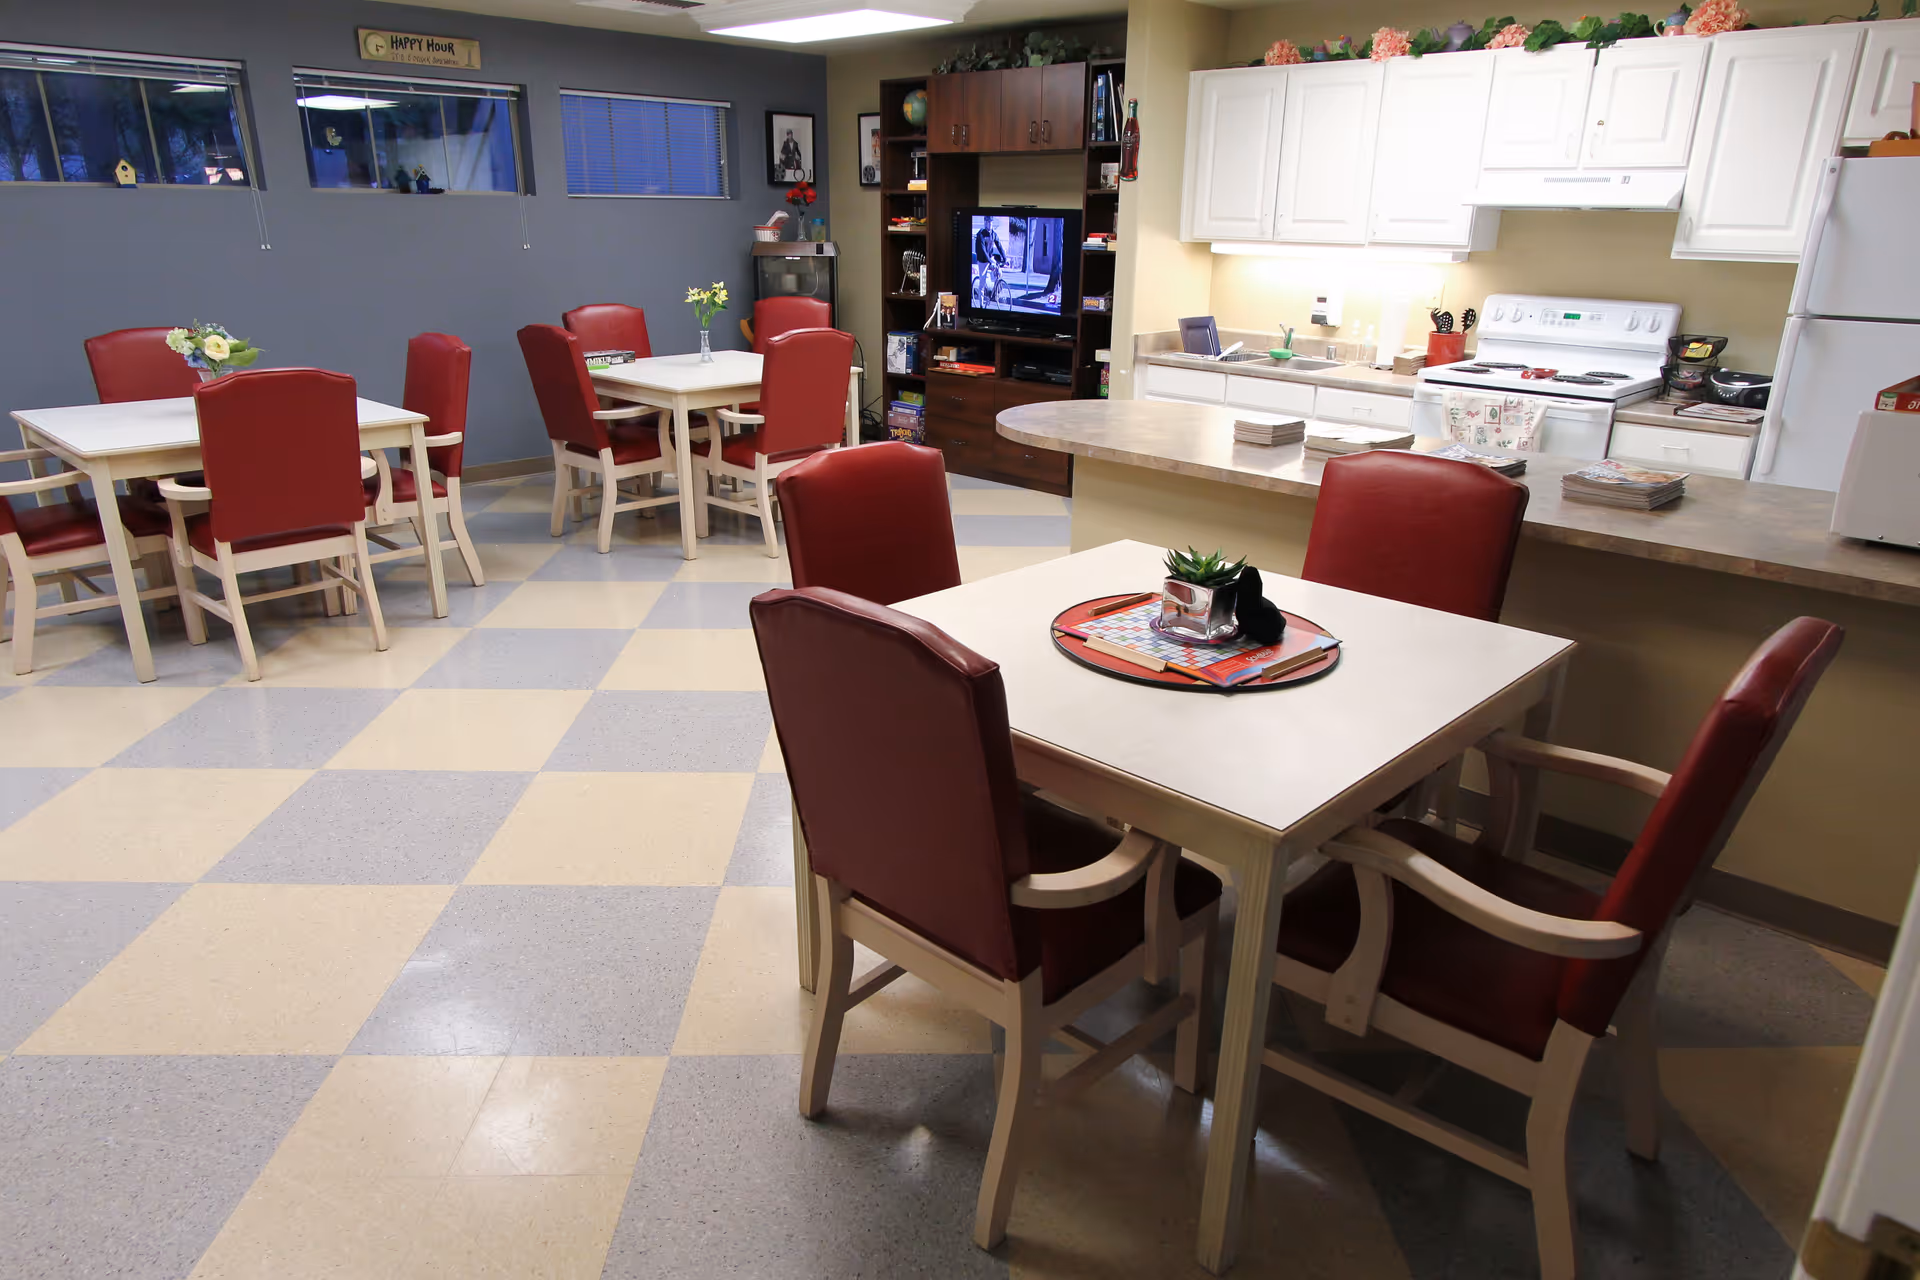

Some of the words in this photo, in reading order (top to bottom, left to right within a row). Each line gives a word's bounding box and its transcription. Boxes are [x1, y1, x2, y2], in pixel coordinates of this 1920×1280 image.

[390, 35, 423, 51] HAPPY
[427, 39, 455, 56] HOUR
[1049, 295, 1055, 303] 2
